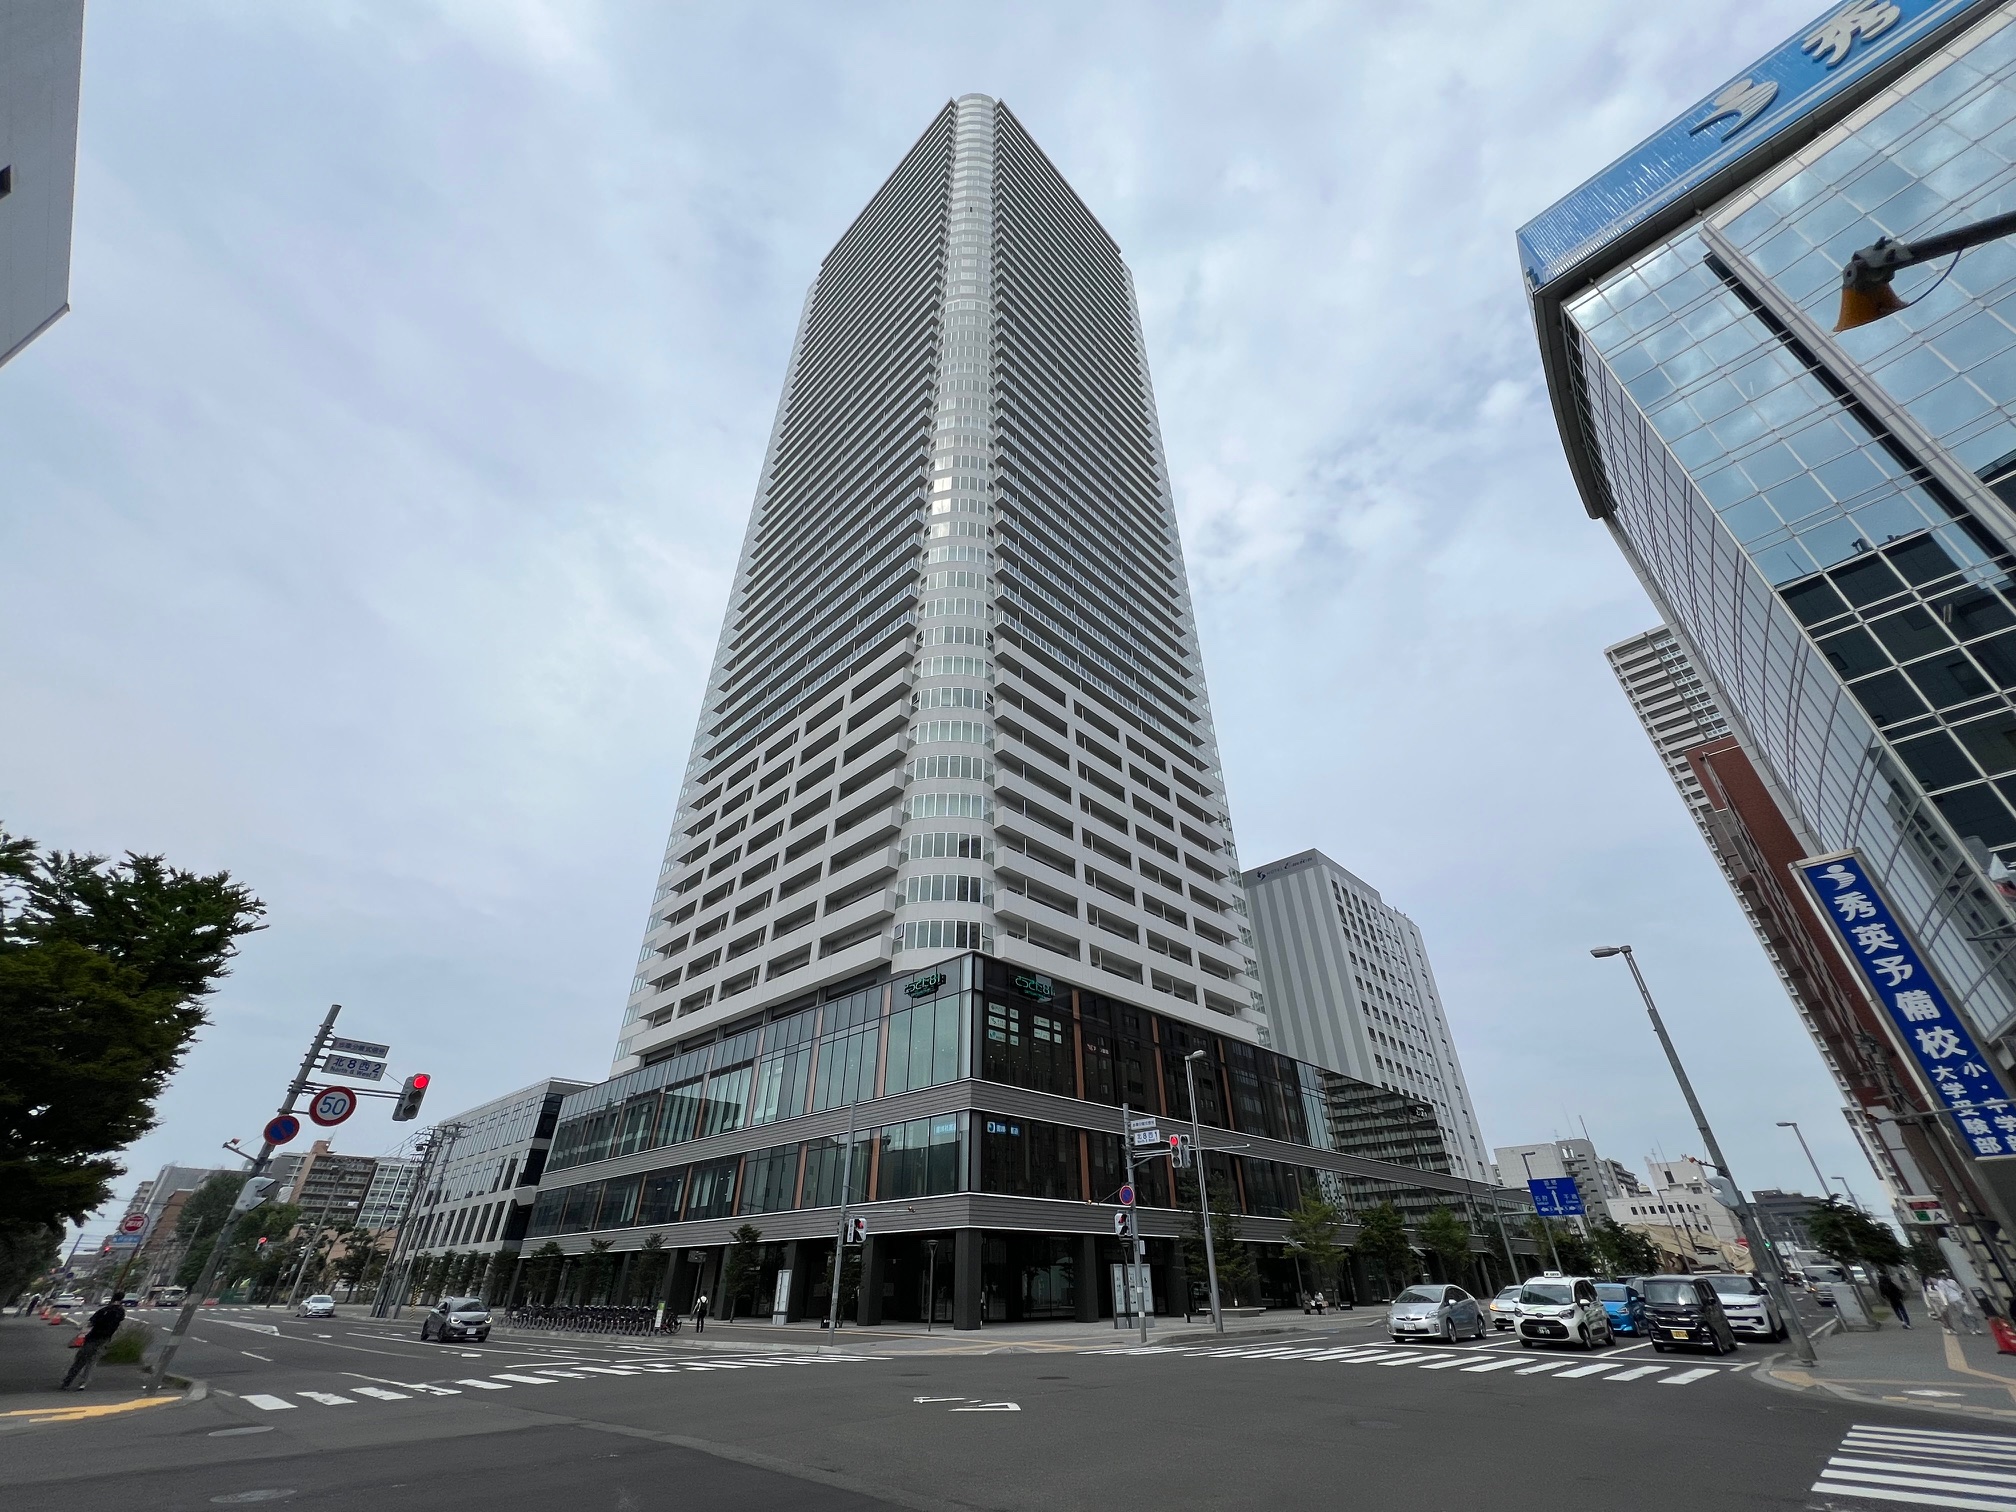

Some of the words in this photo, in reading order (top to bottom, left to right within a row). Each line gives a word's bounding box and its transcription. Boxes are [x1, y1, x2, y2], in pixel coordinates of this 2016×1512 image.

[1834, 891, 1968, 1060] 秀英予備校
[320, 1096, 347, 1115] 50
[1932, 1066, 2002, 1154] 大学受験部
